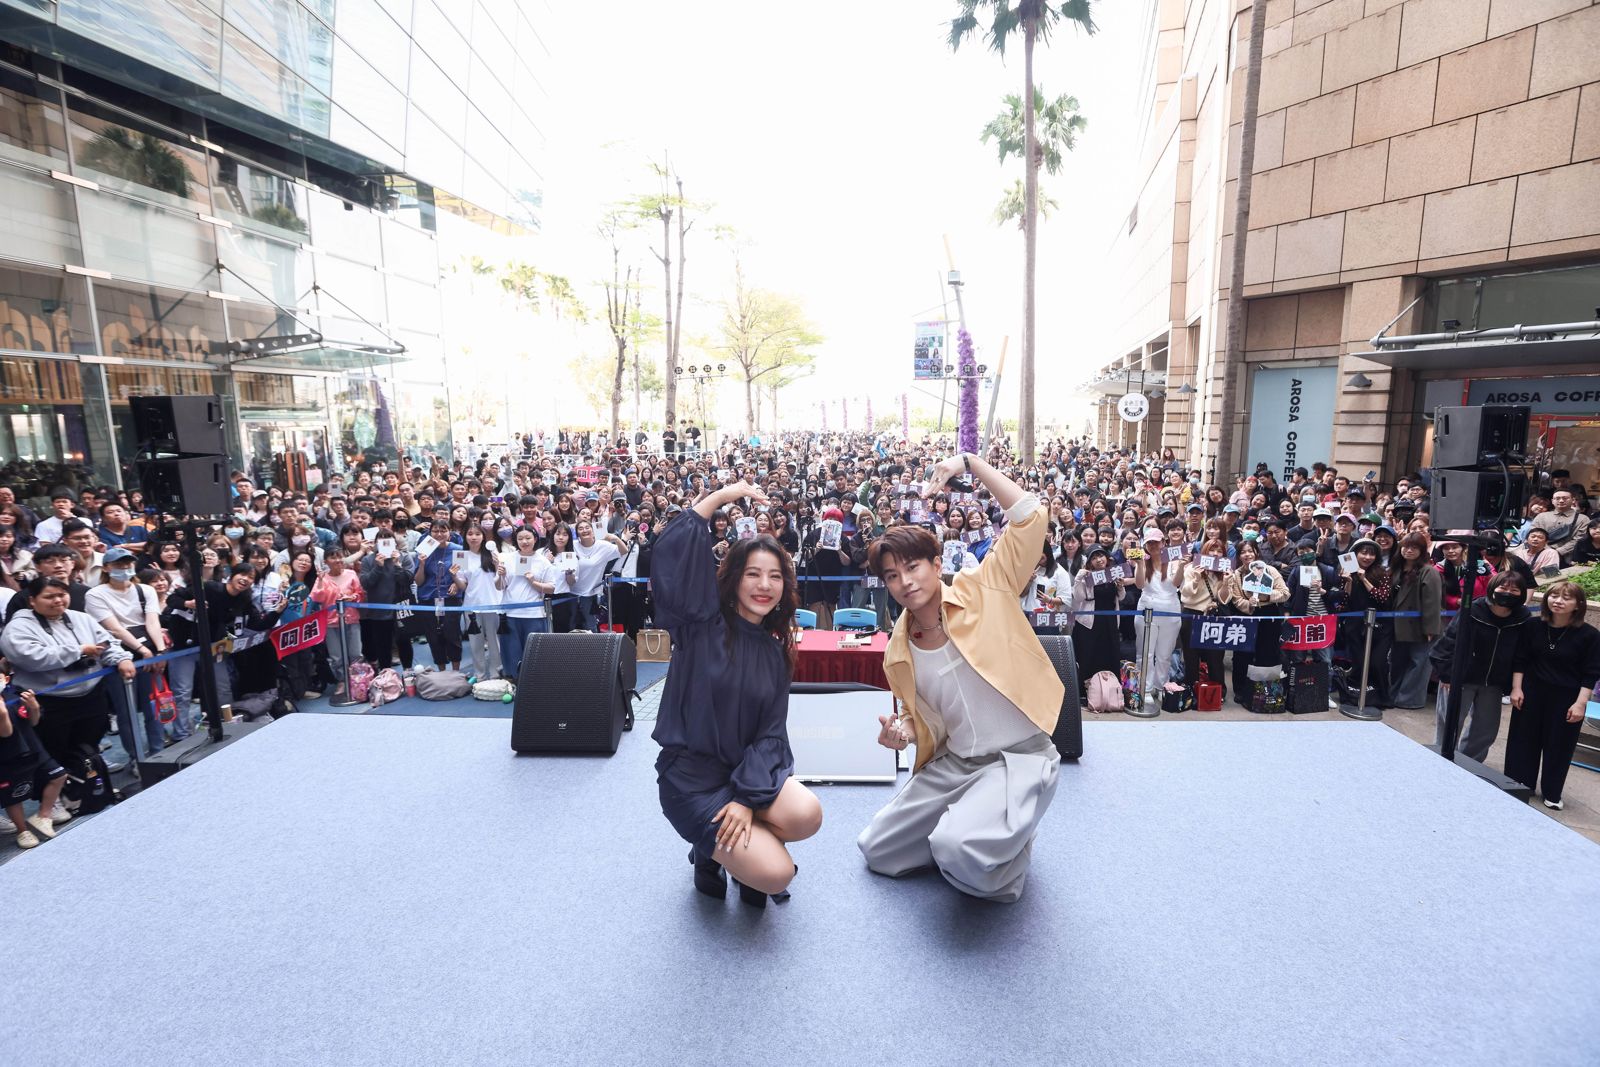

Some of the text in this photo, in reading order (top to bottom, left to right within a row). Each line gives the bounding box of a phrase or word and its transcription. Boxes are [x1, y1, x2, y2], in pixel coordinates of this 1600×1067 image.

[1485, 392, 1542, 403] AROSA
[1283, 378, 1302, 481] AROSA COFFEE
[1200, 555, 1232, 572] 阿弟
[1092, 566, 1125, 585] 阿弟
[1037, 613, 1068, 626] 阿弟
[280, 618, 320, 650] 阿弟
[1200, 622, 1247, 646] 阿弟
